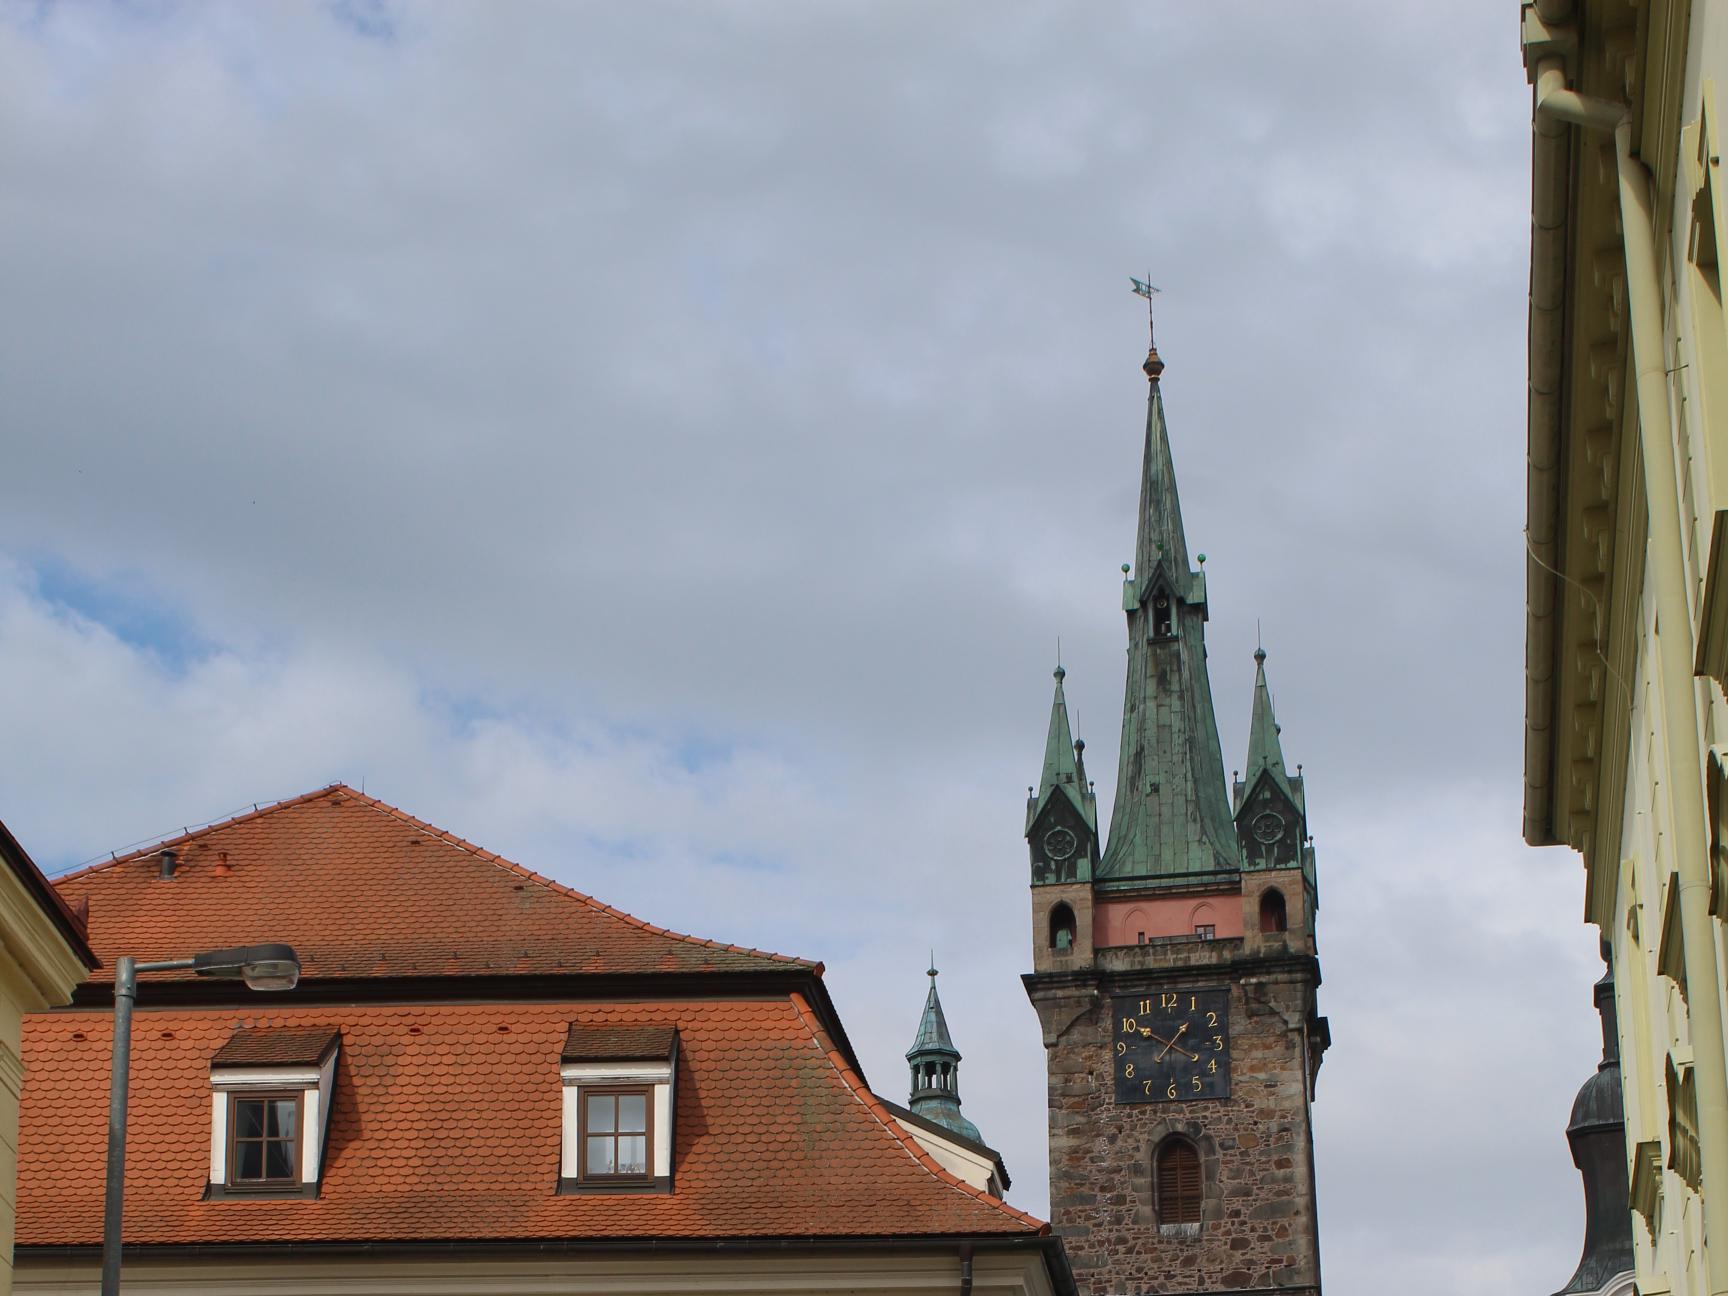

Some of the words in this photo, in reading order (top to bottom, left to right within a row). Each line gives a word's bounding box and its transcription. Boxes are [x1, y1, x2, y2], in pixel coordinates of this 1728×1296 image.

[1138, 999, 1151, 1015] 11
[1160, 993, 1178, 1008] 12
[1189, 996, 1197, 1011] 1
[1121, 1017, 1136, 1033] 10
[1206, 1012, 1218, 1027] 2
[1116, 1042, 1126, 1056] 9
[1212, 1036, 1223, 1051] 3
[1125, 1064, 1135, 1078] 8
[1207, 1058, 1217, 1074] 4
[1143, 1080, 1152, 1095] 7
[1167, 1083, 1176, 1099] 6
[1192, 1075, 1202, 1092] 5
